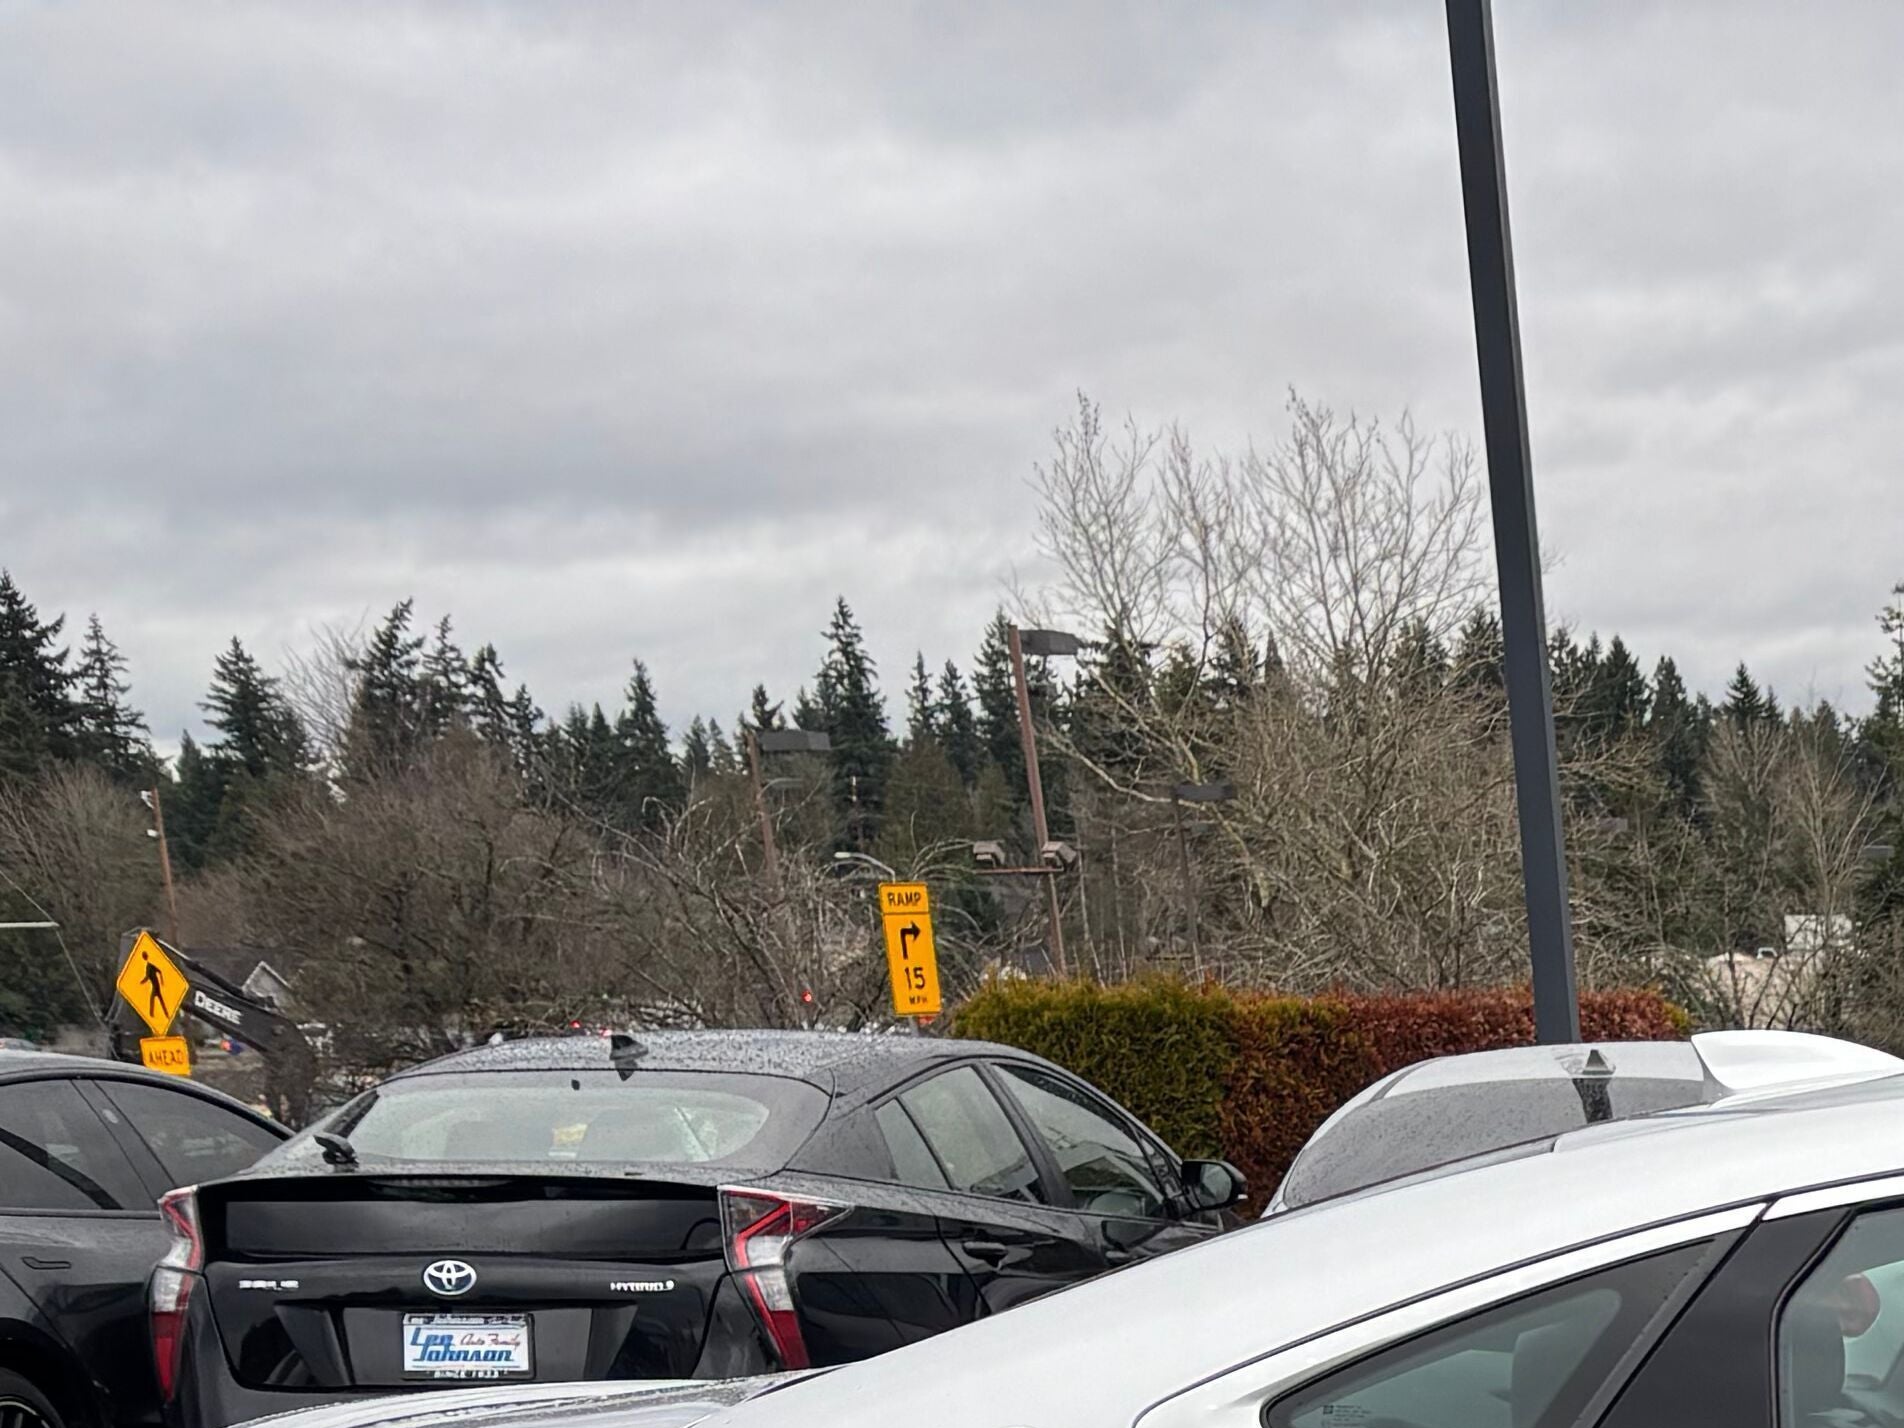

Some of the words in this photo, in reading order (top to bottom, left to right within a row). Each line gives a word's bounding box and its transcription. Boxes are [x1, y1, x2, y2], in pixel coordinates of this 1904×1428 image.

[887, 891, 921, 907] RAMP
[904, 966, 926, 990] 15
[194, 990, 244, 1025] DEERE
[150, 1049, 184, 1066] AHEAD
[410, 1327, 455, 1346] Lee
[412, 1343, 515, 1362] Johnson
